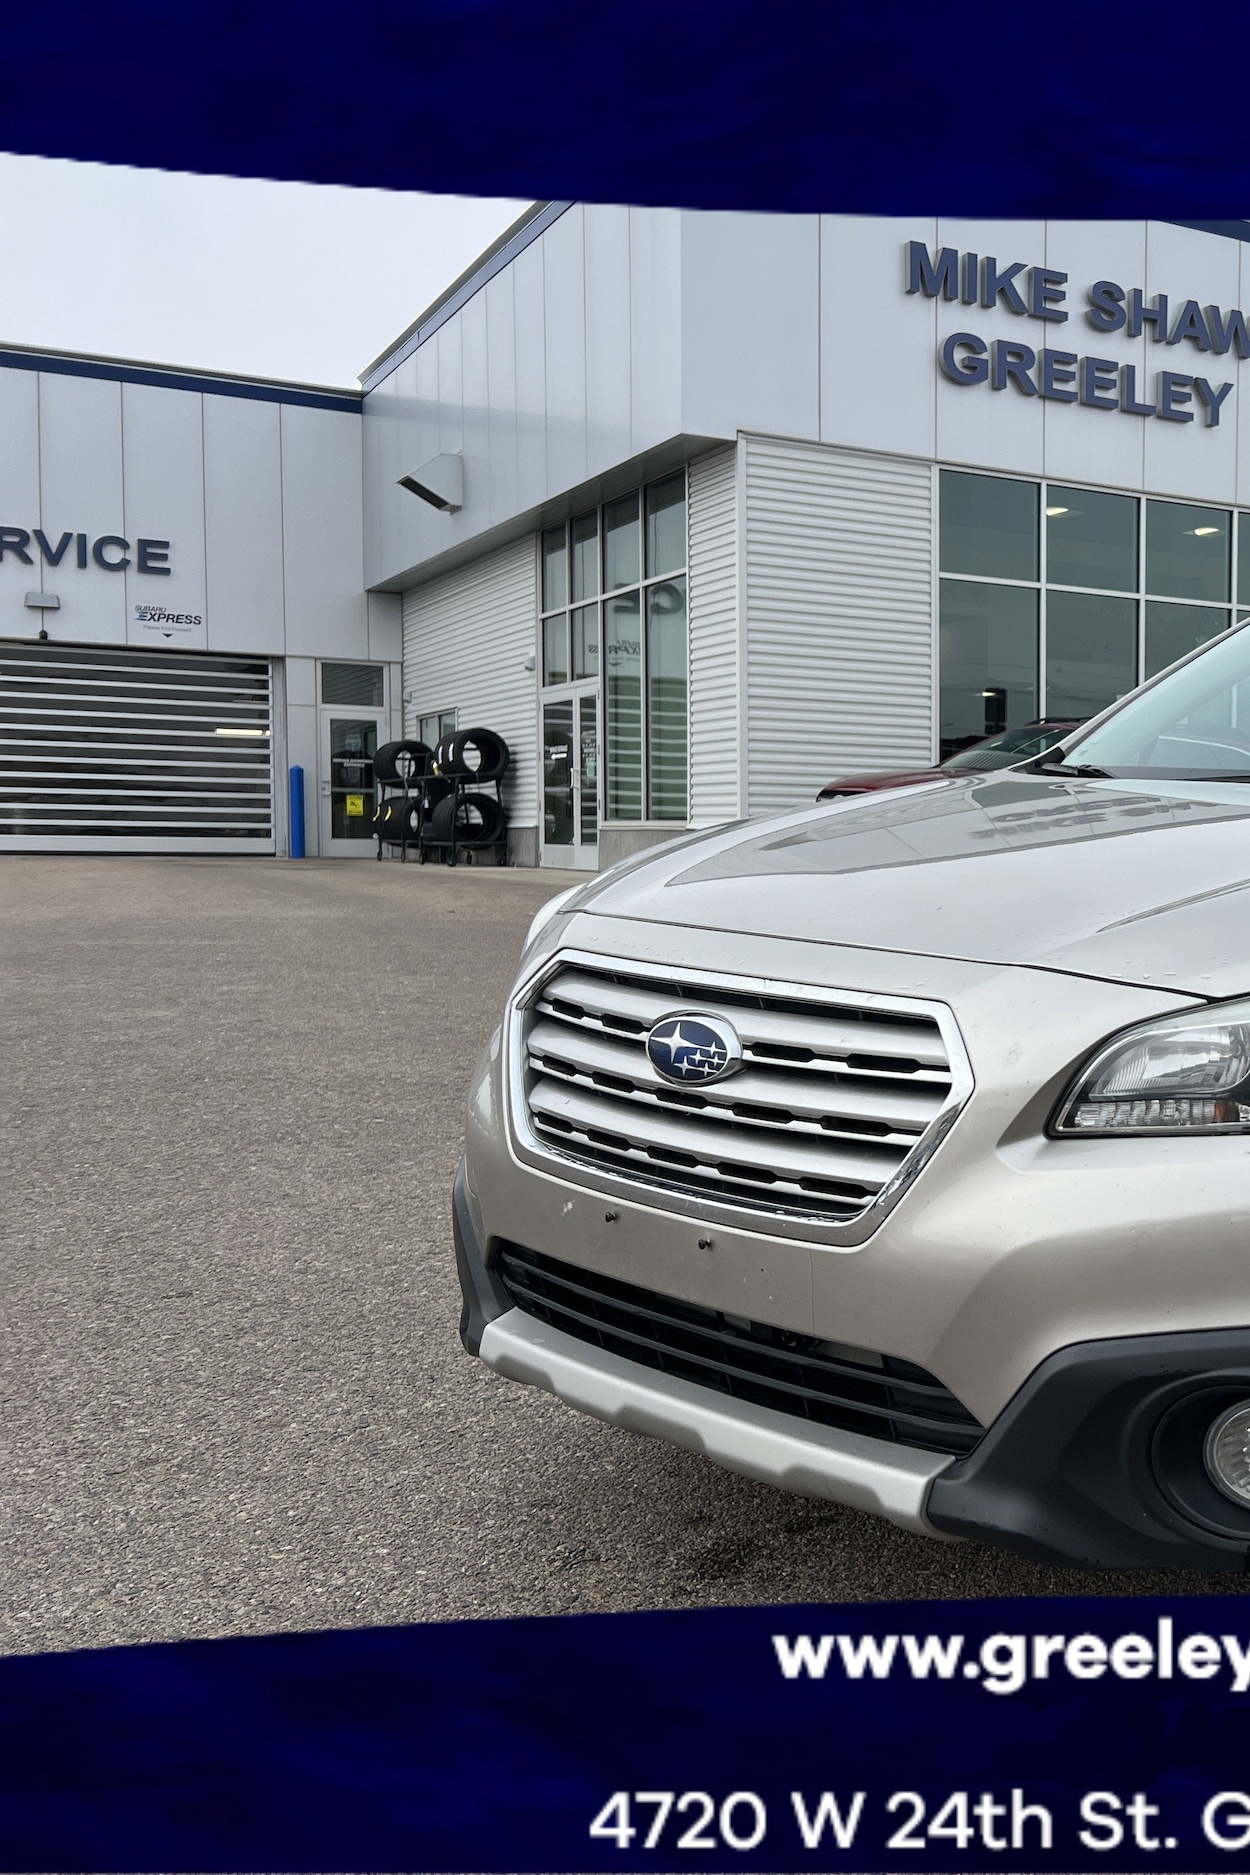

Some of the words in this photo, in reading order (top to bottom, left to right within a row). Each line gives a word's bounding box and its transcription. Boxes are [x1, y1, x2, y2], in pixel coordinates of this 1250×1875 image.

[905, 239, 1069, 324] MIKE
[938, 331, 1235, 428] GREELEY
[134, 611, 203, 626] EXPRESS
[135, 605, 166, 613] SUBARU
